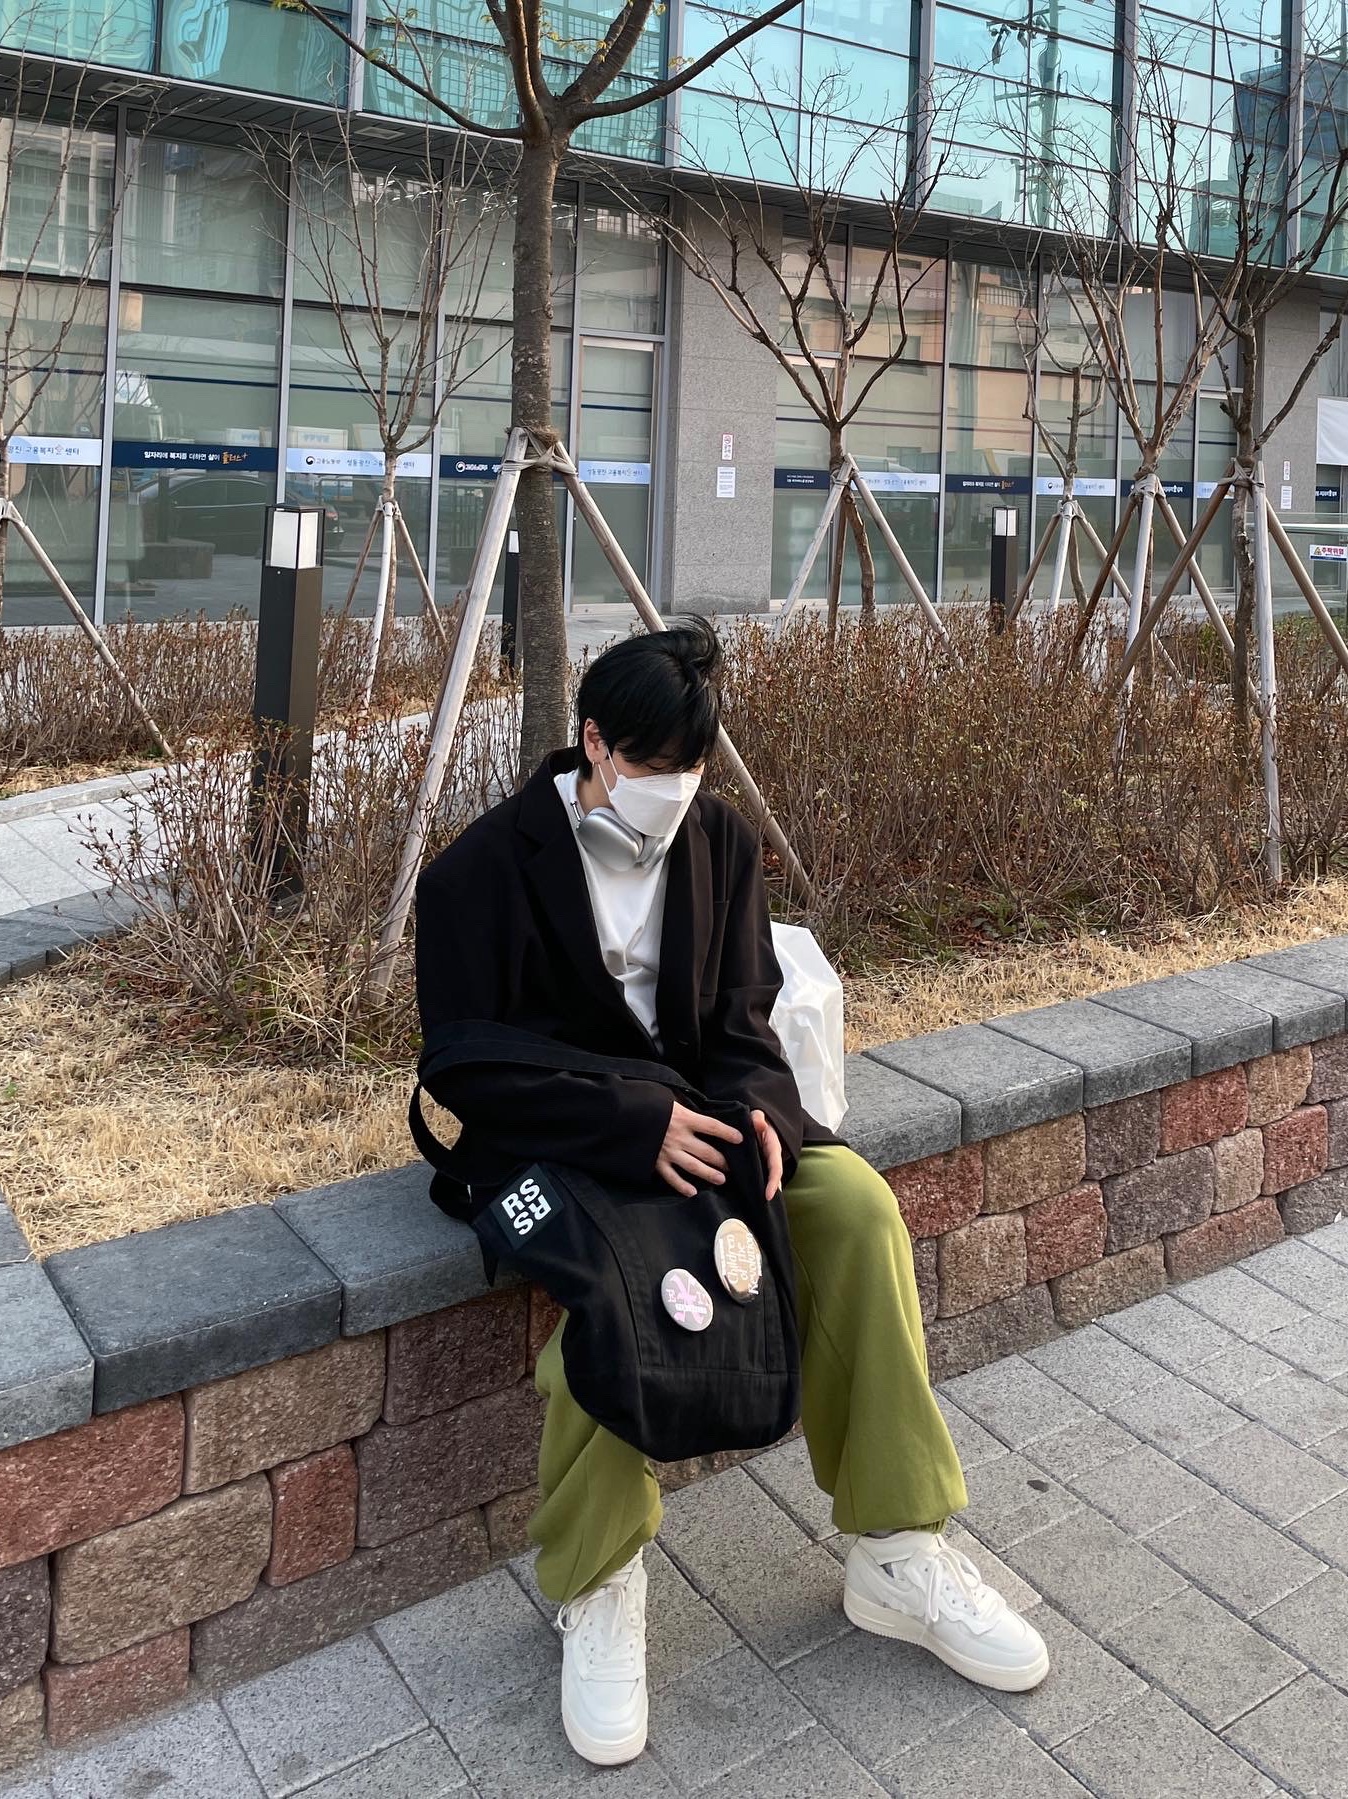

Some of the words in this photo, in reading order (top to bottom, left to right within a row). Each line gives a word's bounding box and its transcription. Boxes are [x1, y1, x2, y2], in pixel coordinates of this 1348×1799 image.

[25, 445, 54, 455] 고용복지
[65, 447, 80, 456] 센터
[144, 450, 168, 459] 일자리에
[169, 451, 188, 460] 복지를
[188, 452, 207, 461] 더하면
[207, 453, 220, 462] 삶이
[726, 1233, 740, 1285] Children
